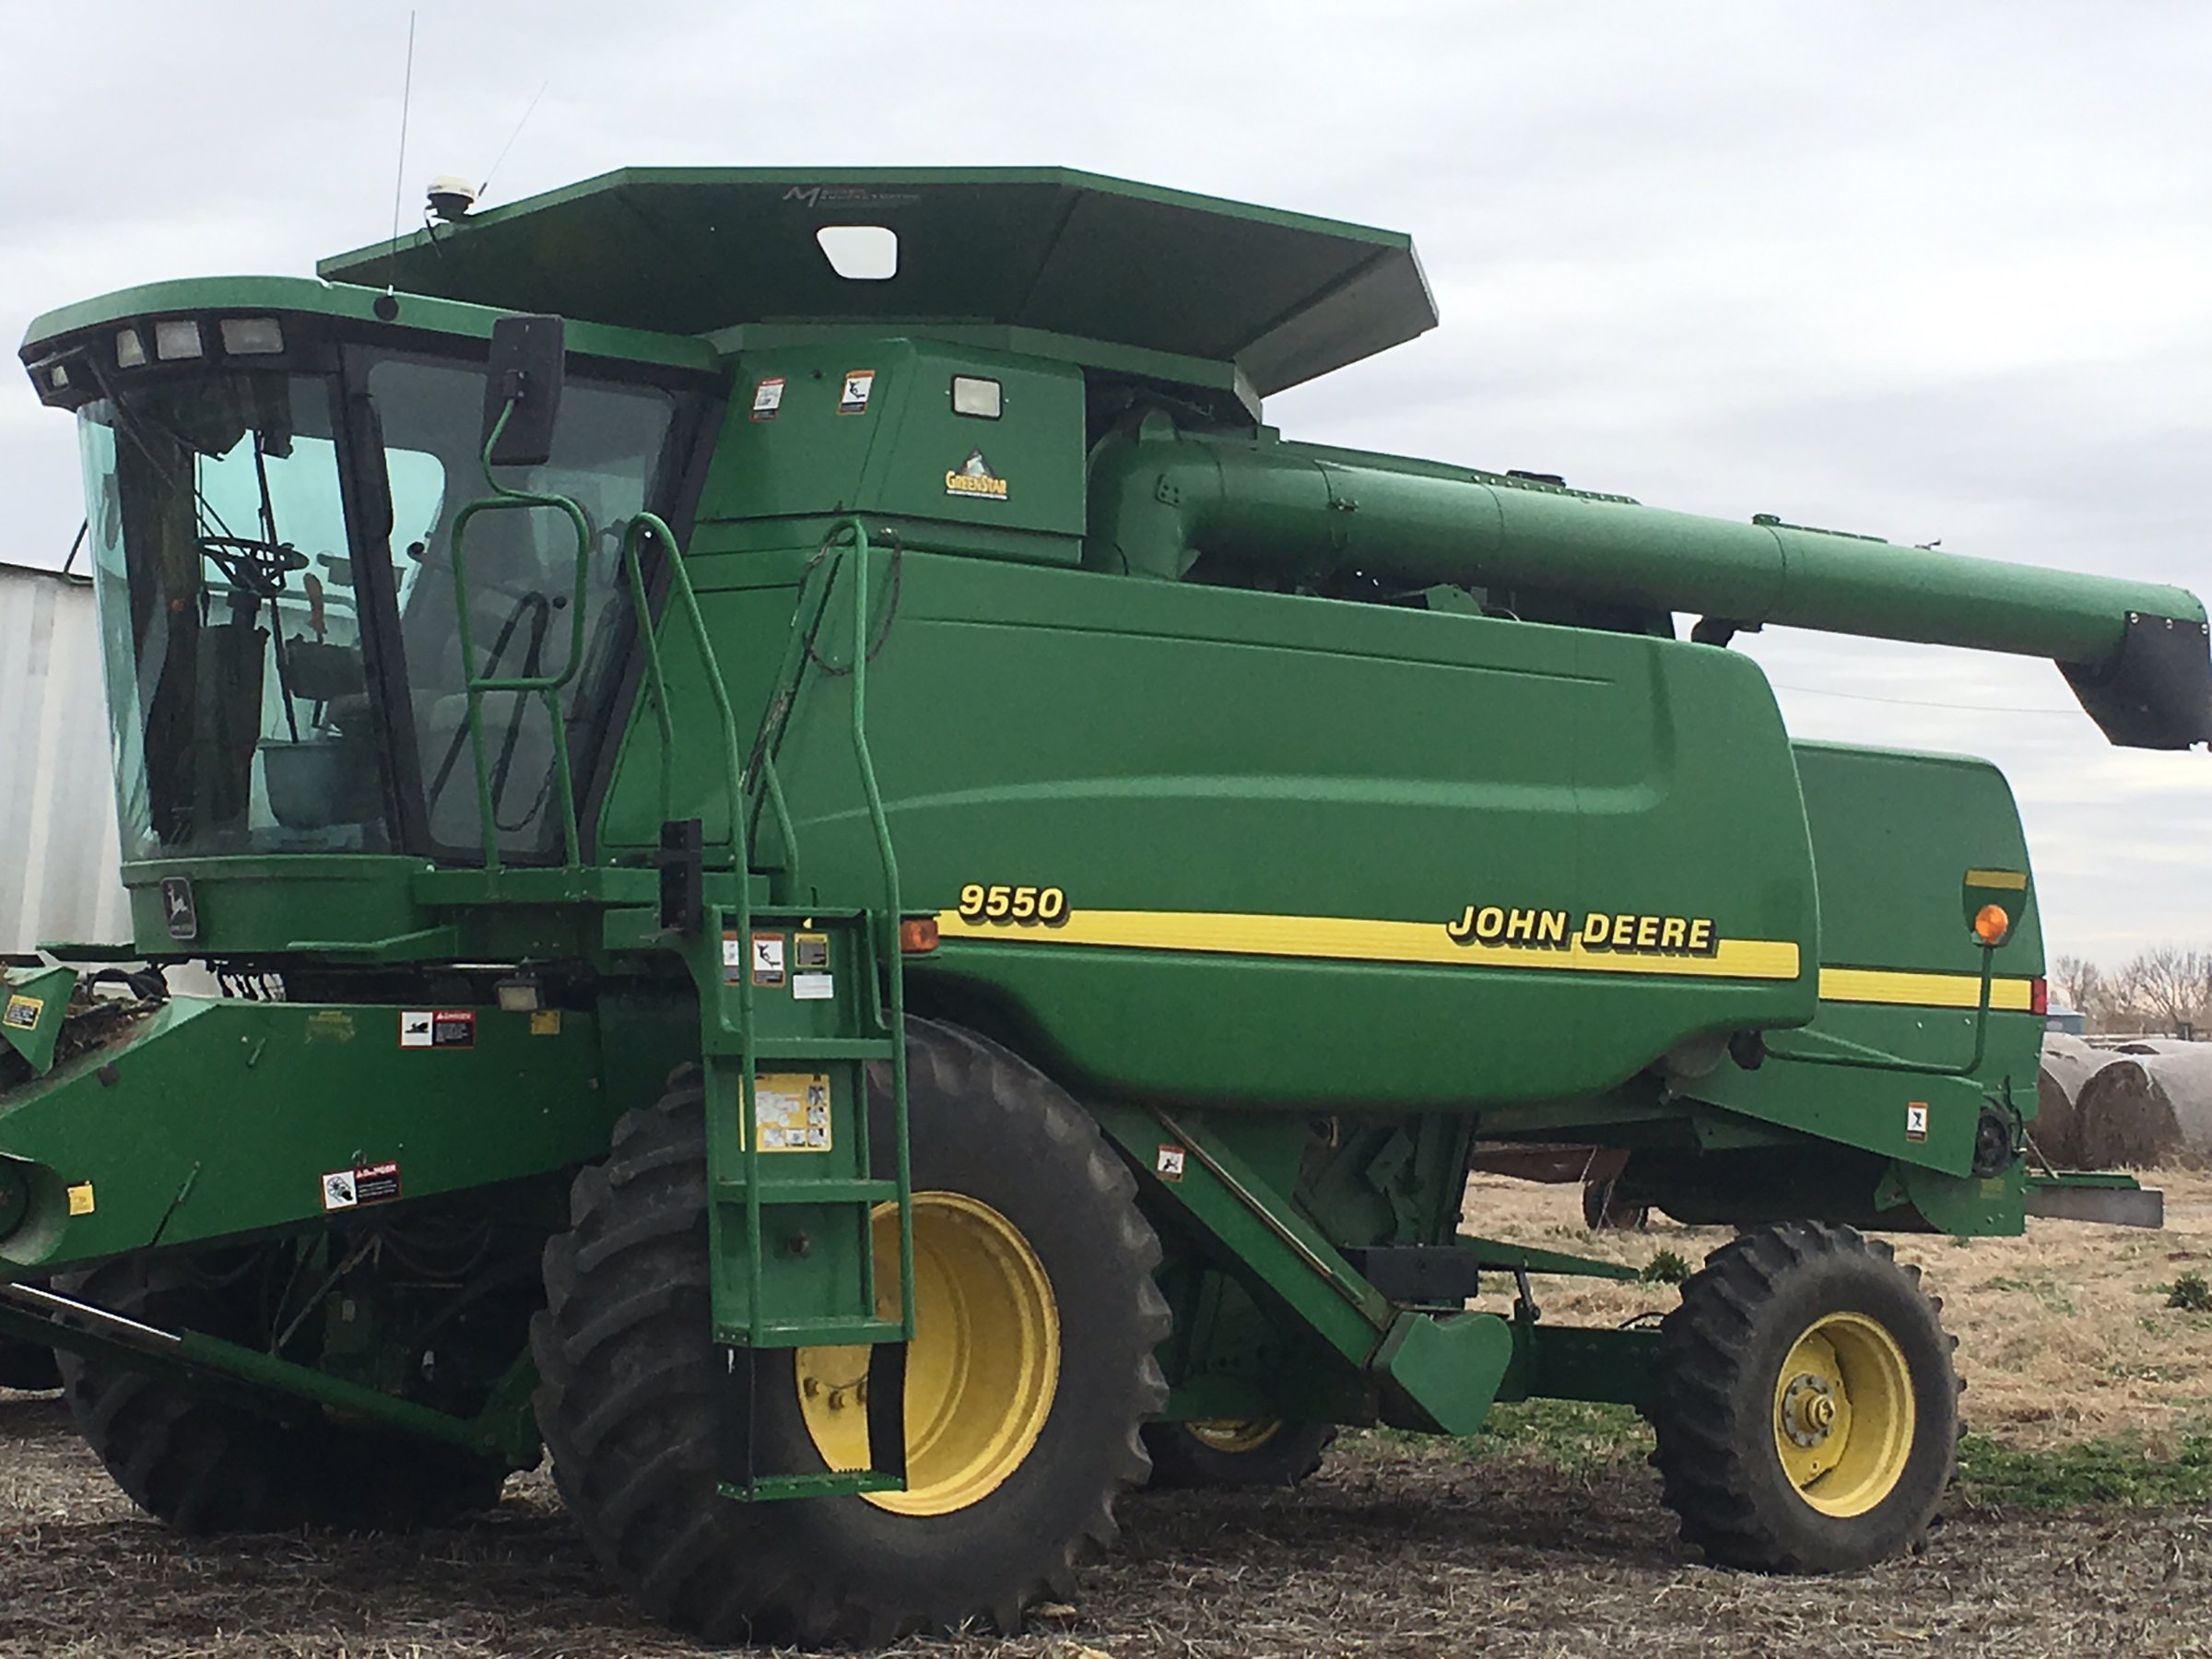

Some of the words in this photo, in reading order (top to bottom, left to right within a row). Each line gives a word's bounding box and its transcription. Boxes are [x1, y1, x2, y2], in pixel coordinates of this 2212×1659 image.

[959, 883, 1066, 924] 9550
[1447, 905, 1569, 947] JOHN
[1582, 912, 1716, 955] DEERE
